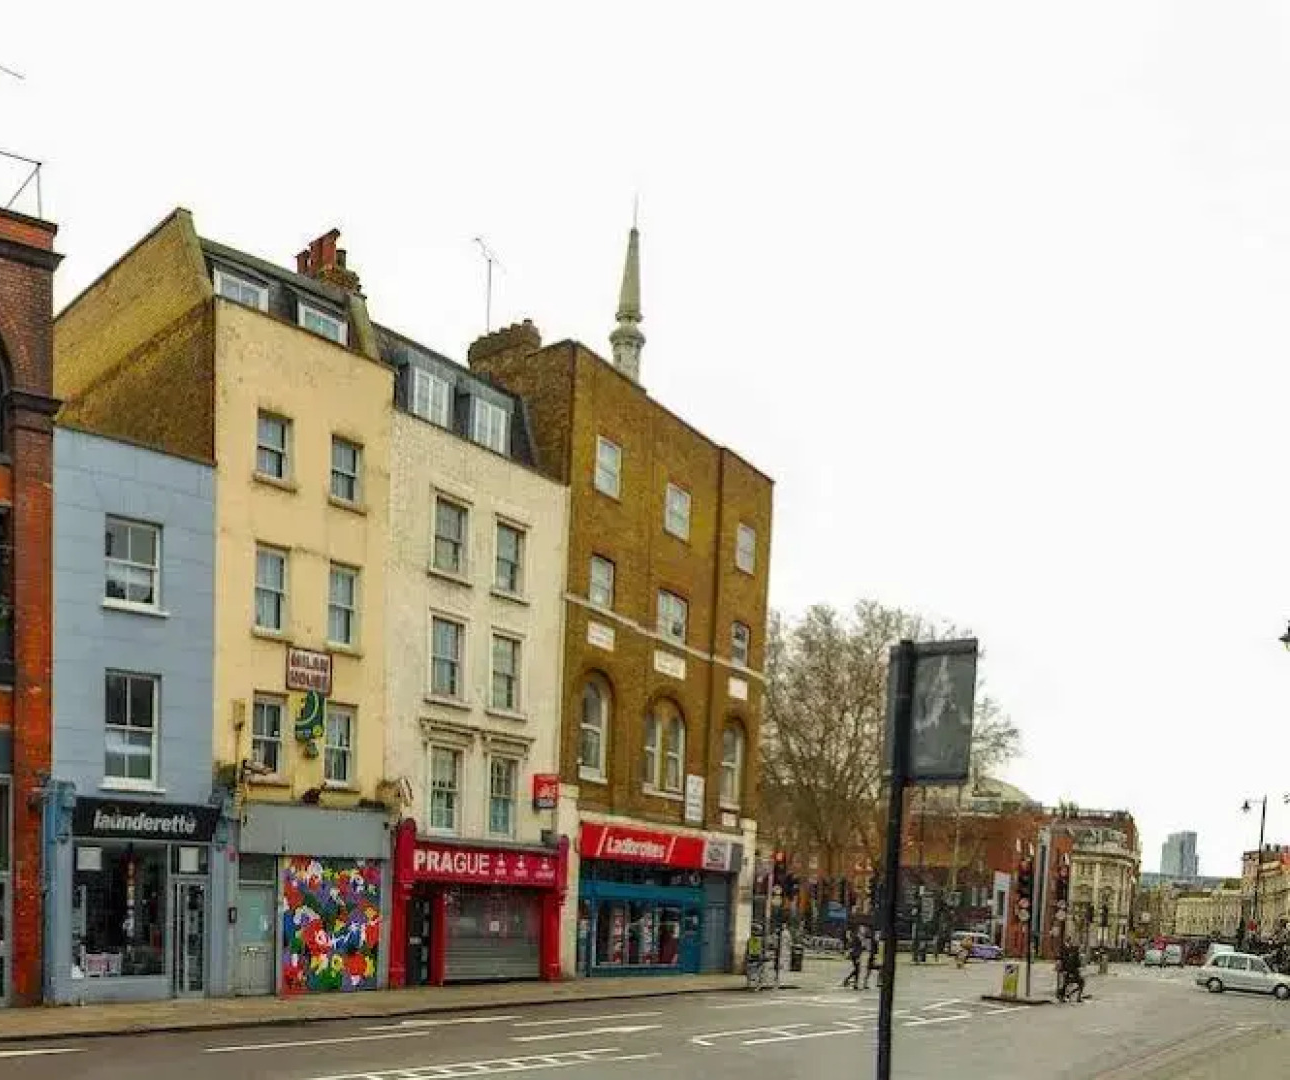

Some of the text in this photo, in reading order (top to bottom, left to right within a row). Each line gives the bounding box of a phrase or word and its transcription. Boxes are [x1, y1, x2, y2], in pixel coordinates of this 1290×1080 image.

[93, 808, 197, 835] launderette
[605, 835, 665, 859] Ladbrokes
[413, 849, 490, 876] PRAGUE
